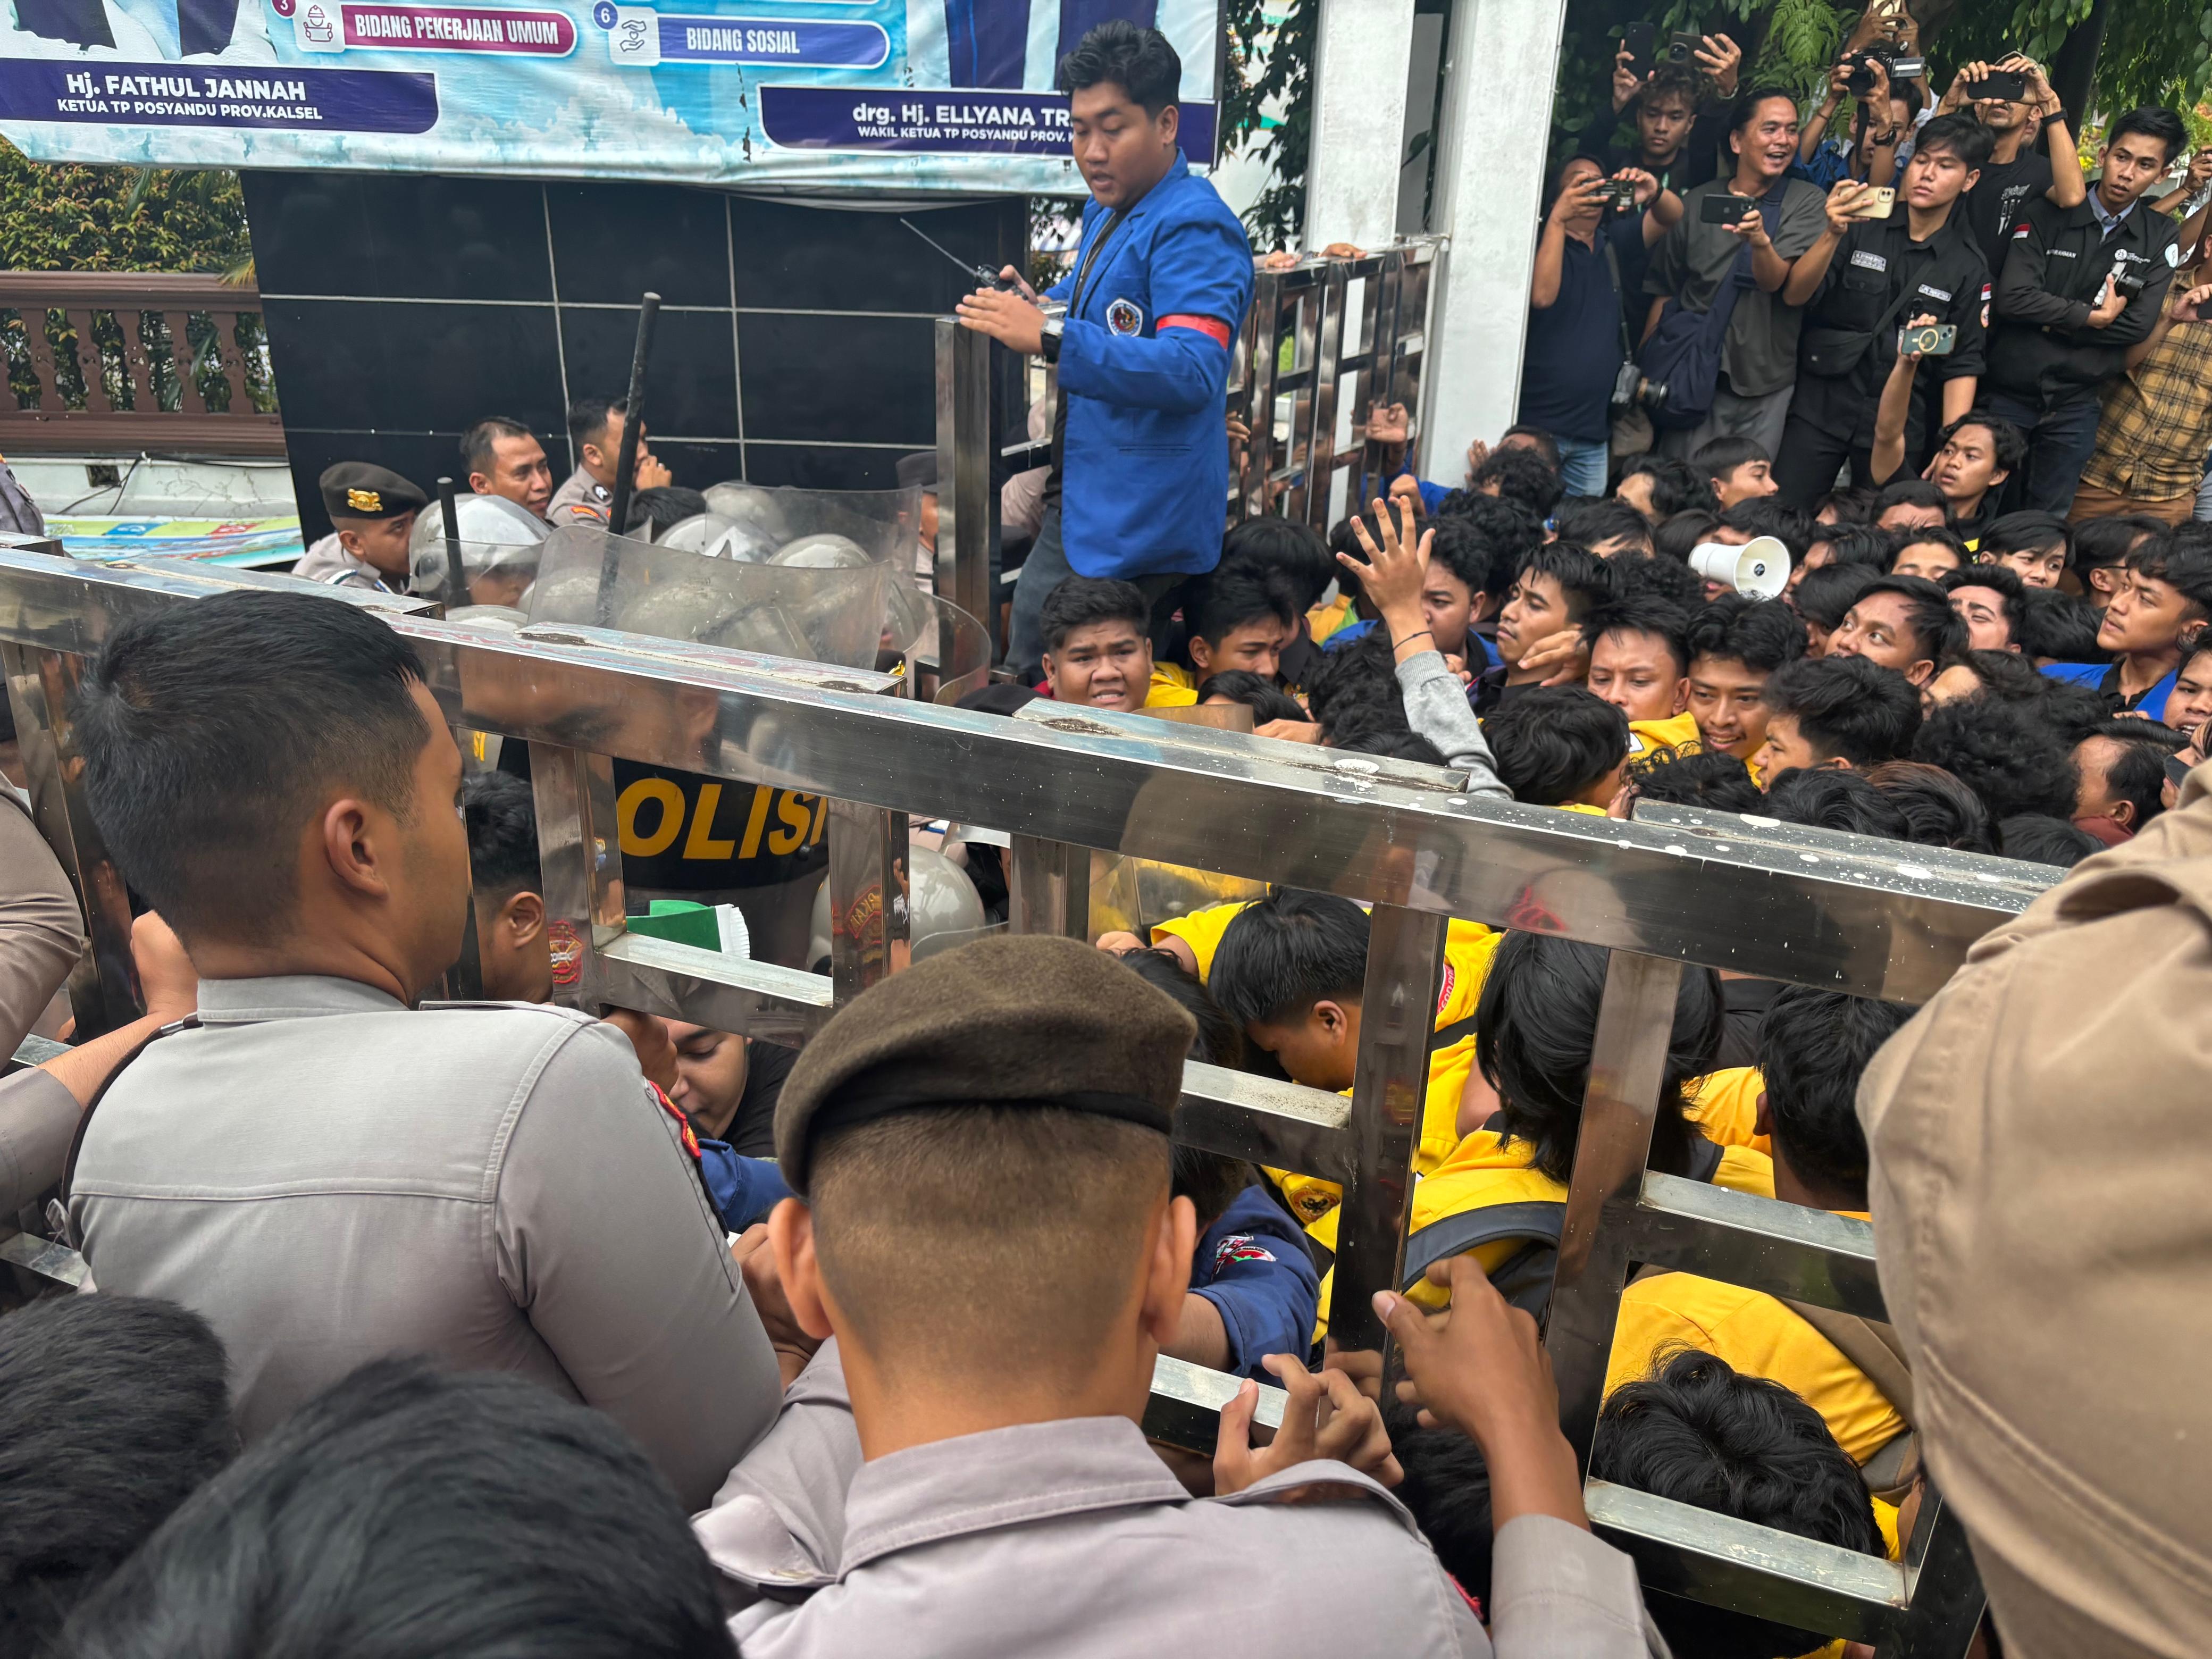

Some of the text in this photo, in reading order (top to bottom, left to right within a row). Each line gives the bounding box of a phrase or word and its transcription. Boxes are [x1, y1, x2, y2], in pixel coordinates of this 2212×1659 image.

[601, 8, 610, 23] 6
[355, 15, 558, 44] BIDANG PEKERJAAN UMUM
[687, 28, 800, 53] BIDANG SOSIAL
[66, 72, 306, 100] Hj. FATHUL JANNAH
[57, 99, 322, 119] KETUA TP POSYANDU PROV.KALSEL
[852, 103, 1073, 127] drg. Hj. ELLYANA TR
[858, 127, 898, 137] WAKIL
[901, 128, 941, 138] KETUA
[944, 128, 959, 138] TP
[962, 129, 1027, 140] POSYANDU
[1031, 131, 1065, 141] PROV.
[616, 777, 828, 860] OLISI
